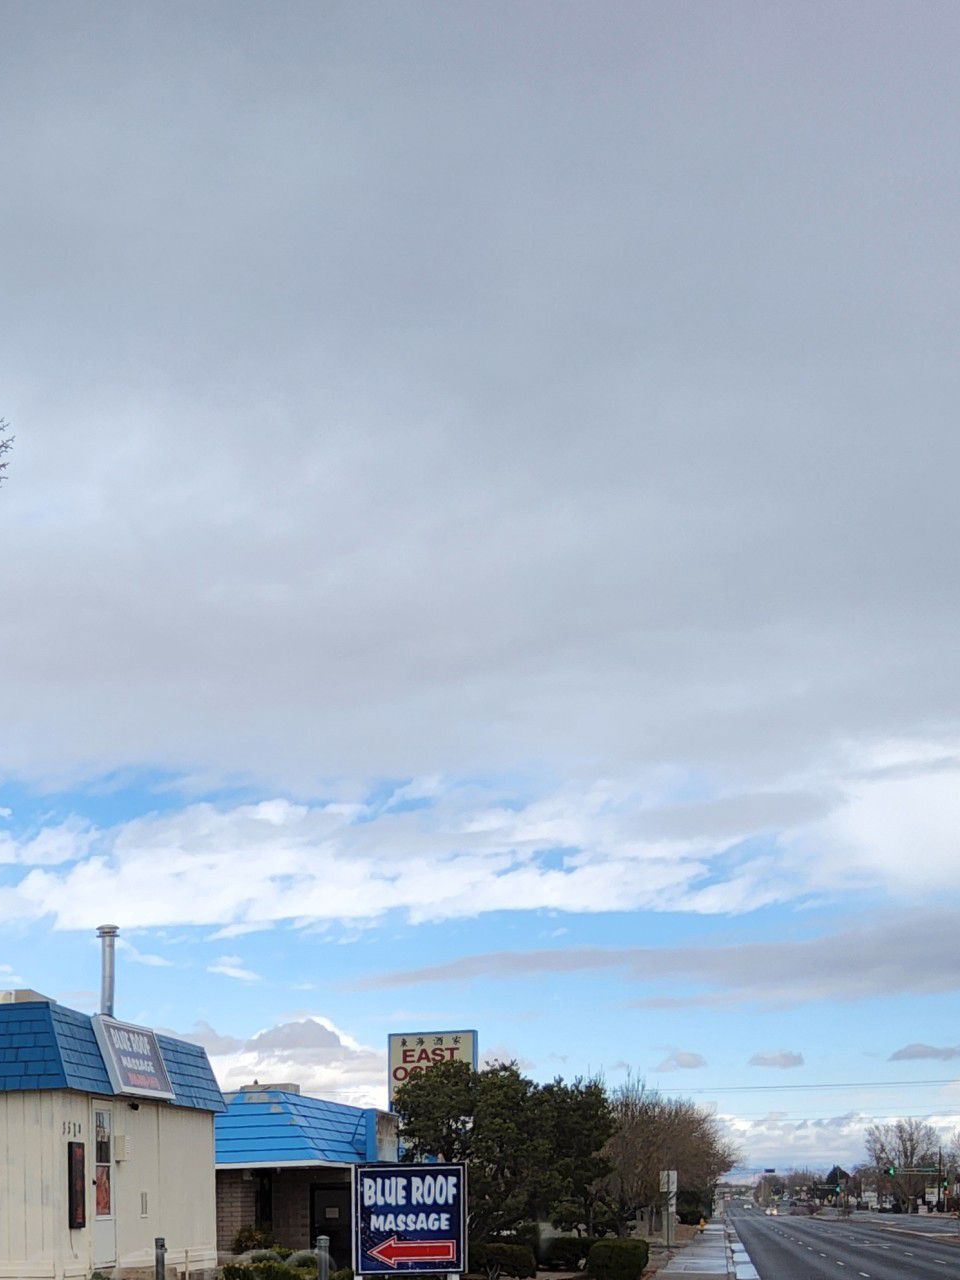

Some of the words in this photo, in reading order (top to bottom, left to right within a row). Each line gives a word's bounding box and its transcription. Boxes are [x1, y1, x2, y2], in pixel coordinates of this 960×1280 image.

[401, 1047, 460, 1064] EAST
[363, 1176, 408, 1206] BLUE
[411, 1174, 458, 1205] ROOF
[370, 1212, 451, 1232] MASSAGE
